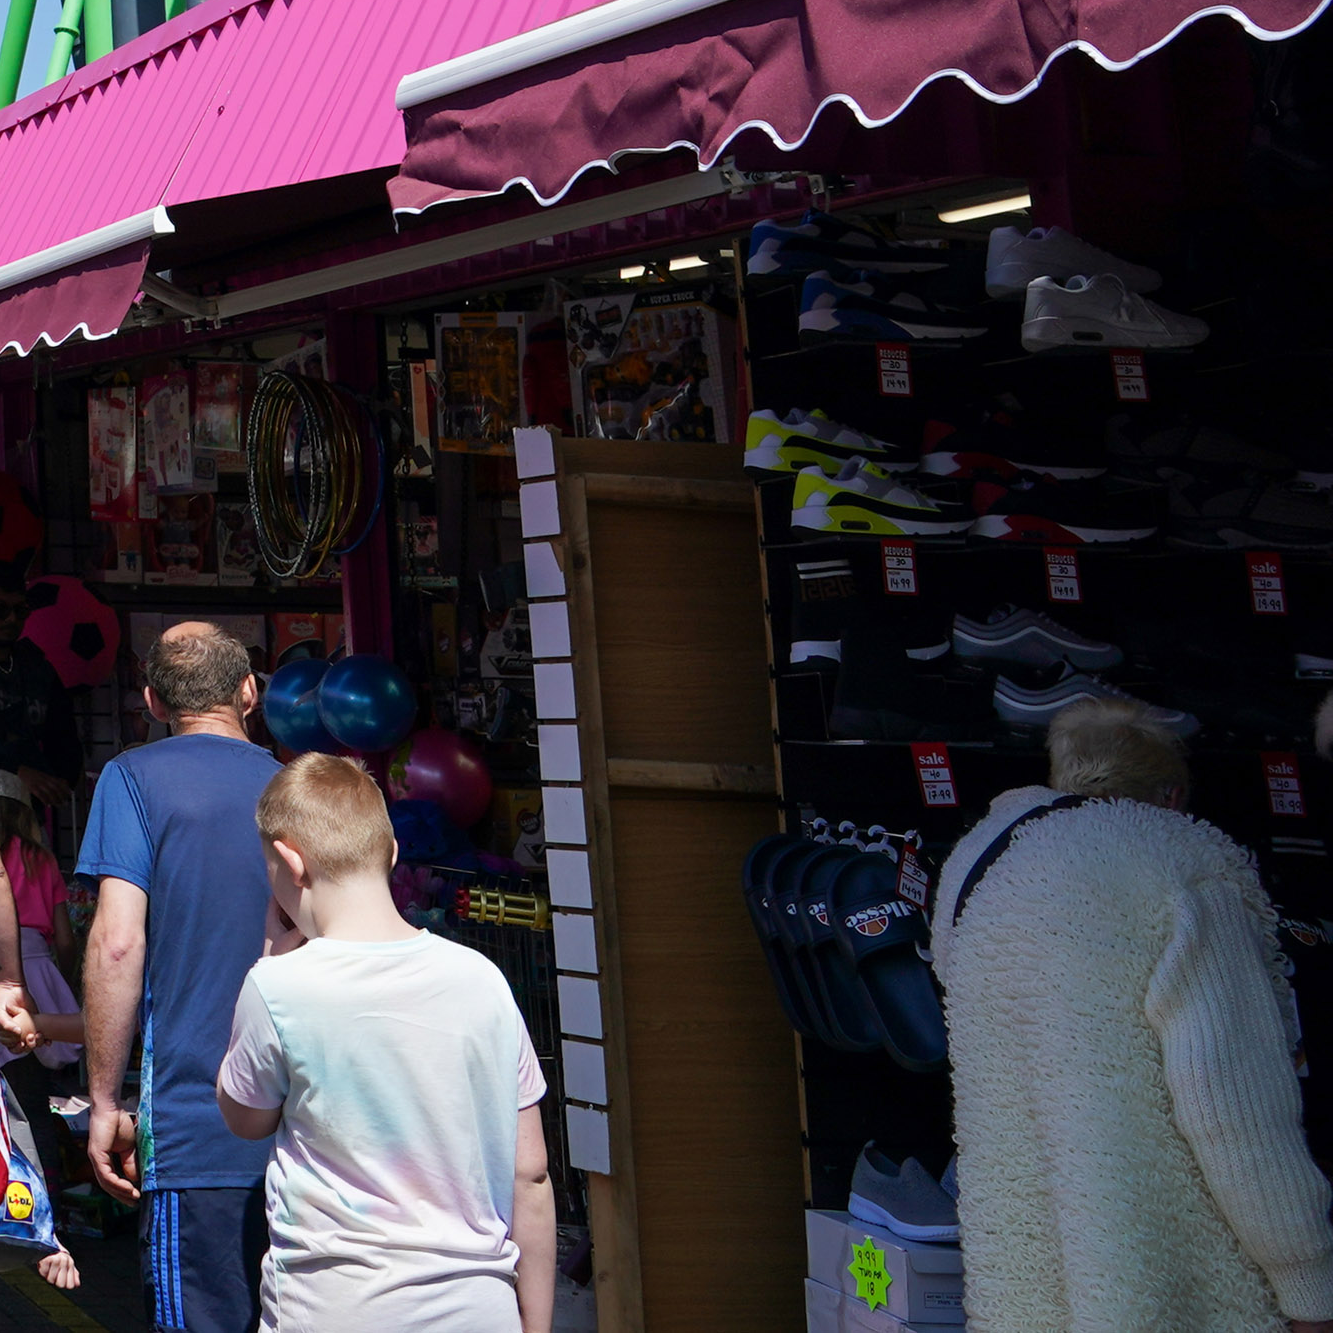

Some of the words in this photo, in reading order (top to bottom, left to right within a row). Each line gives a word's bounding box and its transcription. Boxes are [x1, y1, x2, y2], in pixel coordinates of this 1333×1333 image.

[1251, 561, 1278, 575] sale
[1260, 579, 1272, 589] 40
[918, 752, 945, 765] sale
[1267, 762, 1294, 775] sale
